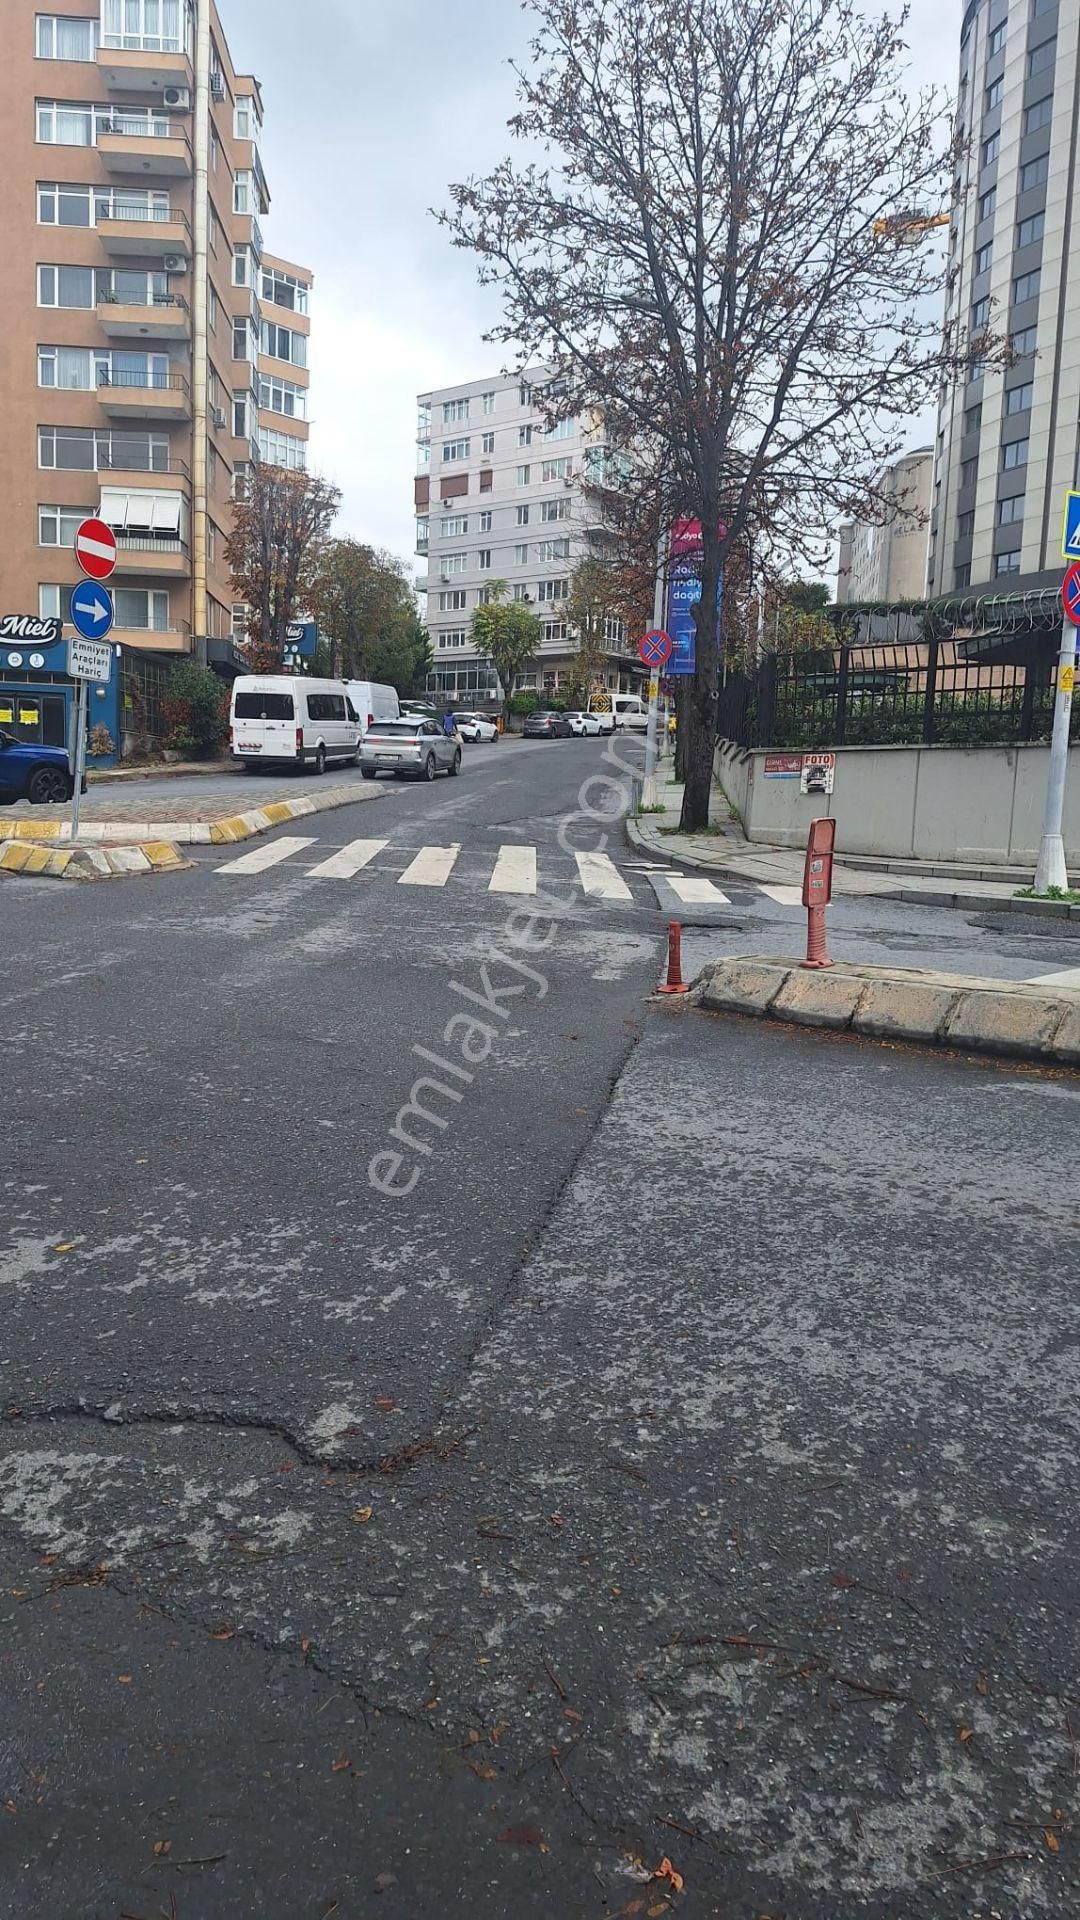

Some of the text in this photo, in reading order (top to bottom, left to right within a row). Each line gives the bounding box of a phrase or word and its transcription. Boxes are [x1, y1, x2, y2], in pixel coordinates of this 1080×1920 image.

[0, 616, 57, 640] Miel
[72, 640, 110, 656] Emniyet
[72, 653, 108, 667] Araçları
[77, 664, 102, 677] Hariç
[805, 755, 830, 764] FOTO
